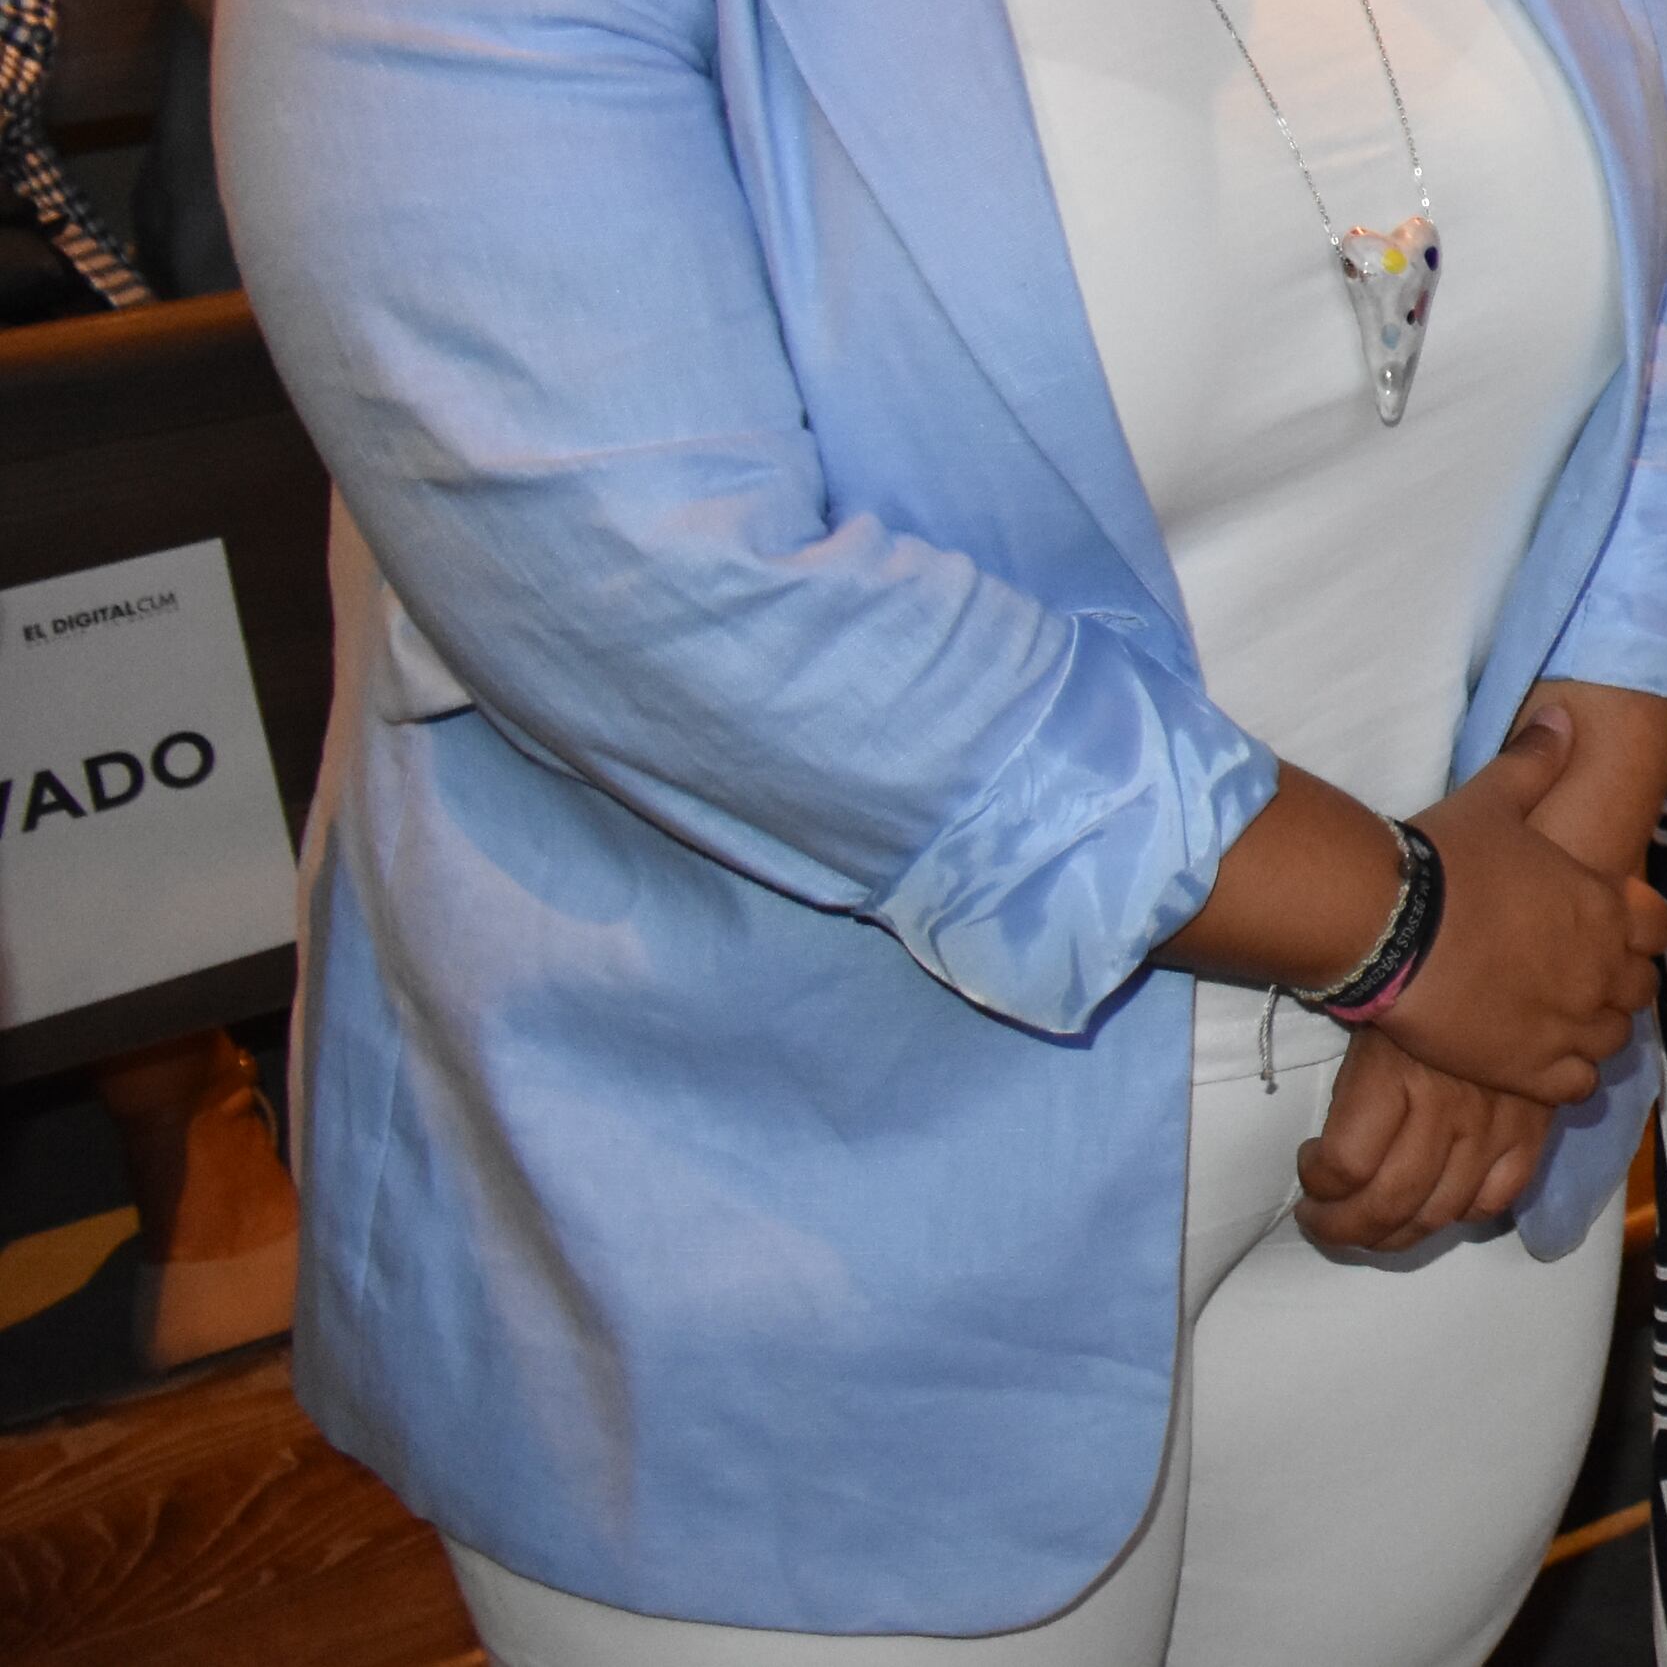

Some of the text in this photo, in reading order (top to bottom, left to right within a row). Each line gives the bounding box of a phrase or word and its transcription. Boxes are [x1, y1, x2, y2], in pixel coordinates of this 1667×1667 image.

[22, 592, 179, 642] EL DIGITALCLM
[0, 731, 215, 839] ADO
